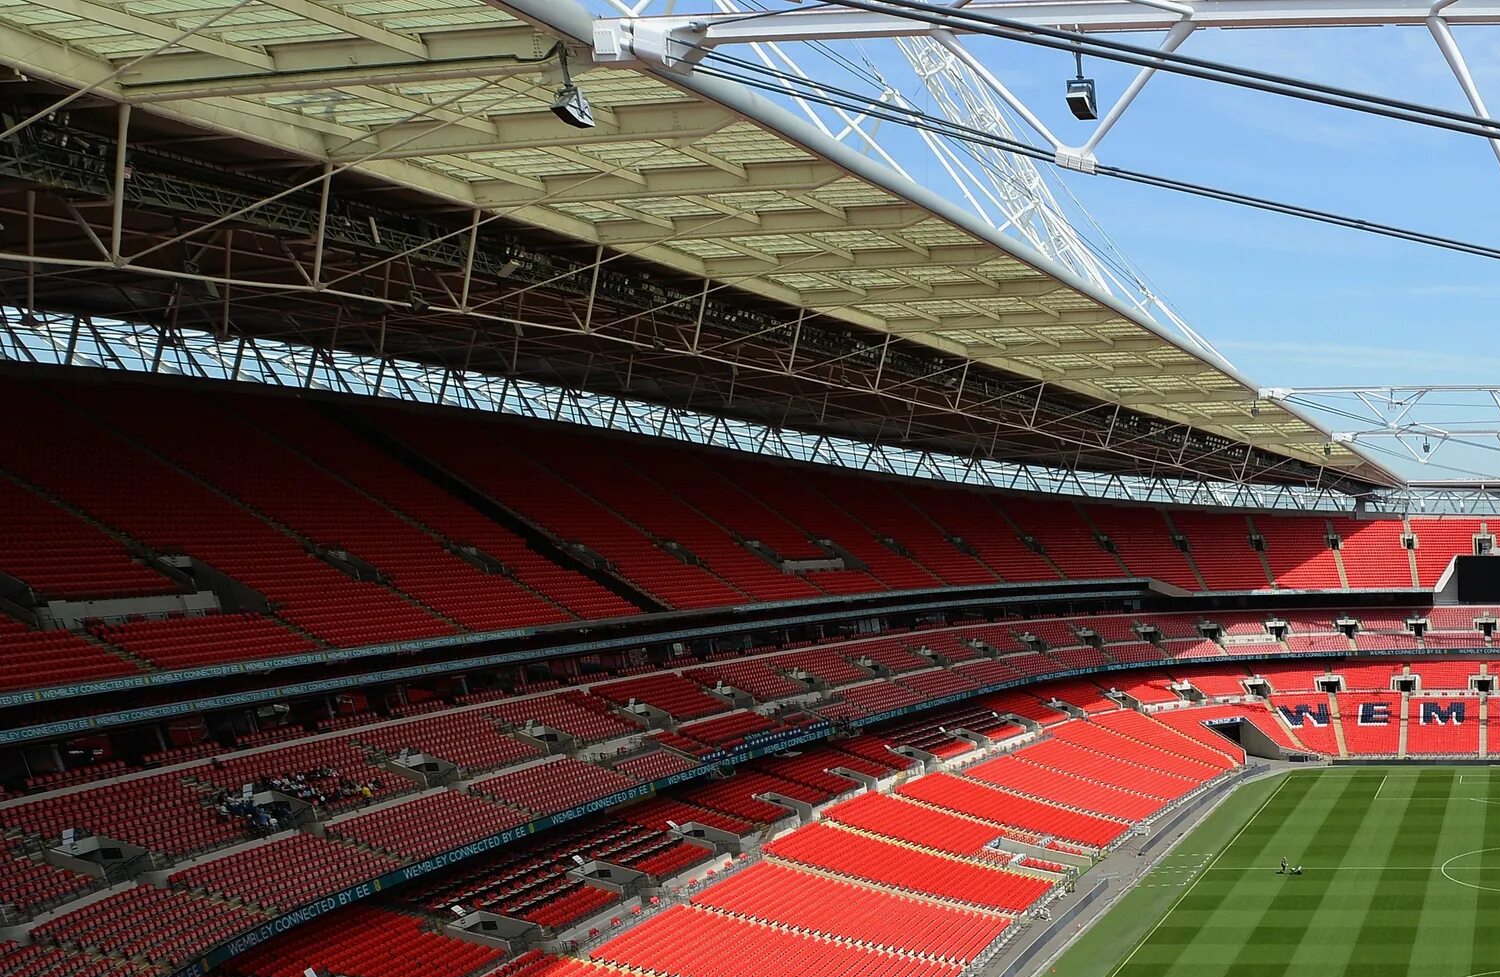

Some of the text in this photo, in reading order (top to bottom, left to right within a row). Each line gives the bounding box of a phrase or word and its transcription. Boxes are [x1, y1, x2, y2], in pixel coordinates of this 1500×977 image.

[551, 784, 648, 824] WEMBLEY CONNECTED BY EE
[403, 826, 526, 879] WEMBLEY CONNECTED BY EE
[227, 884, 370, 956] WEMBLEY CONNECTED BY EE
